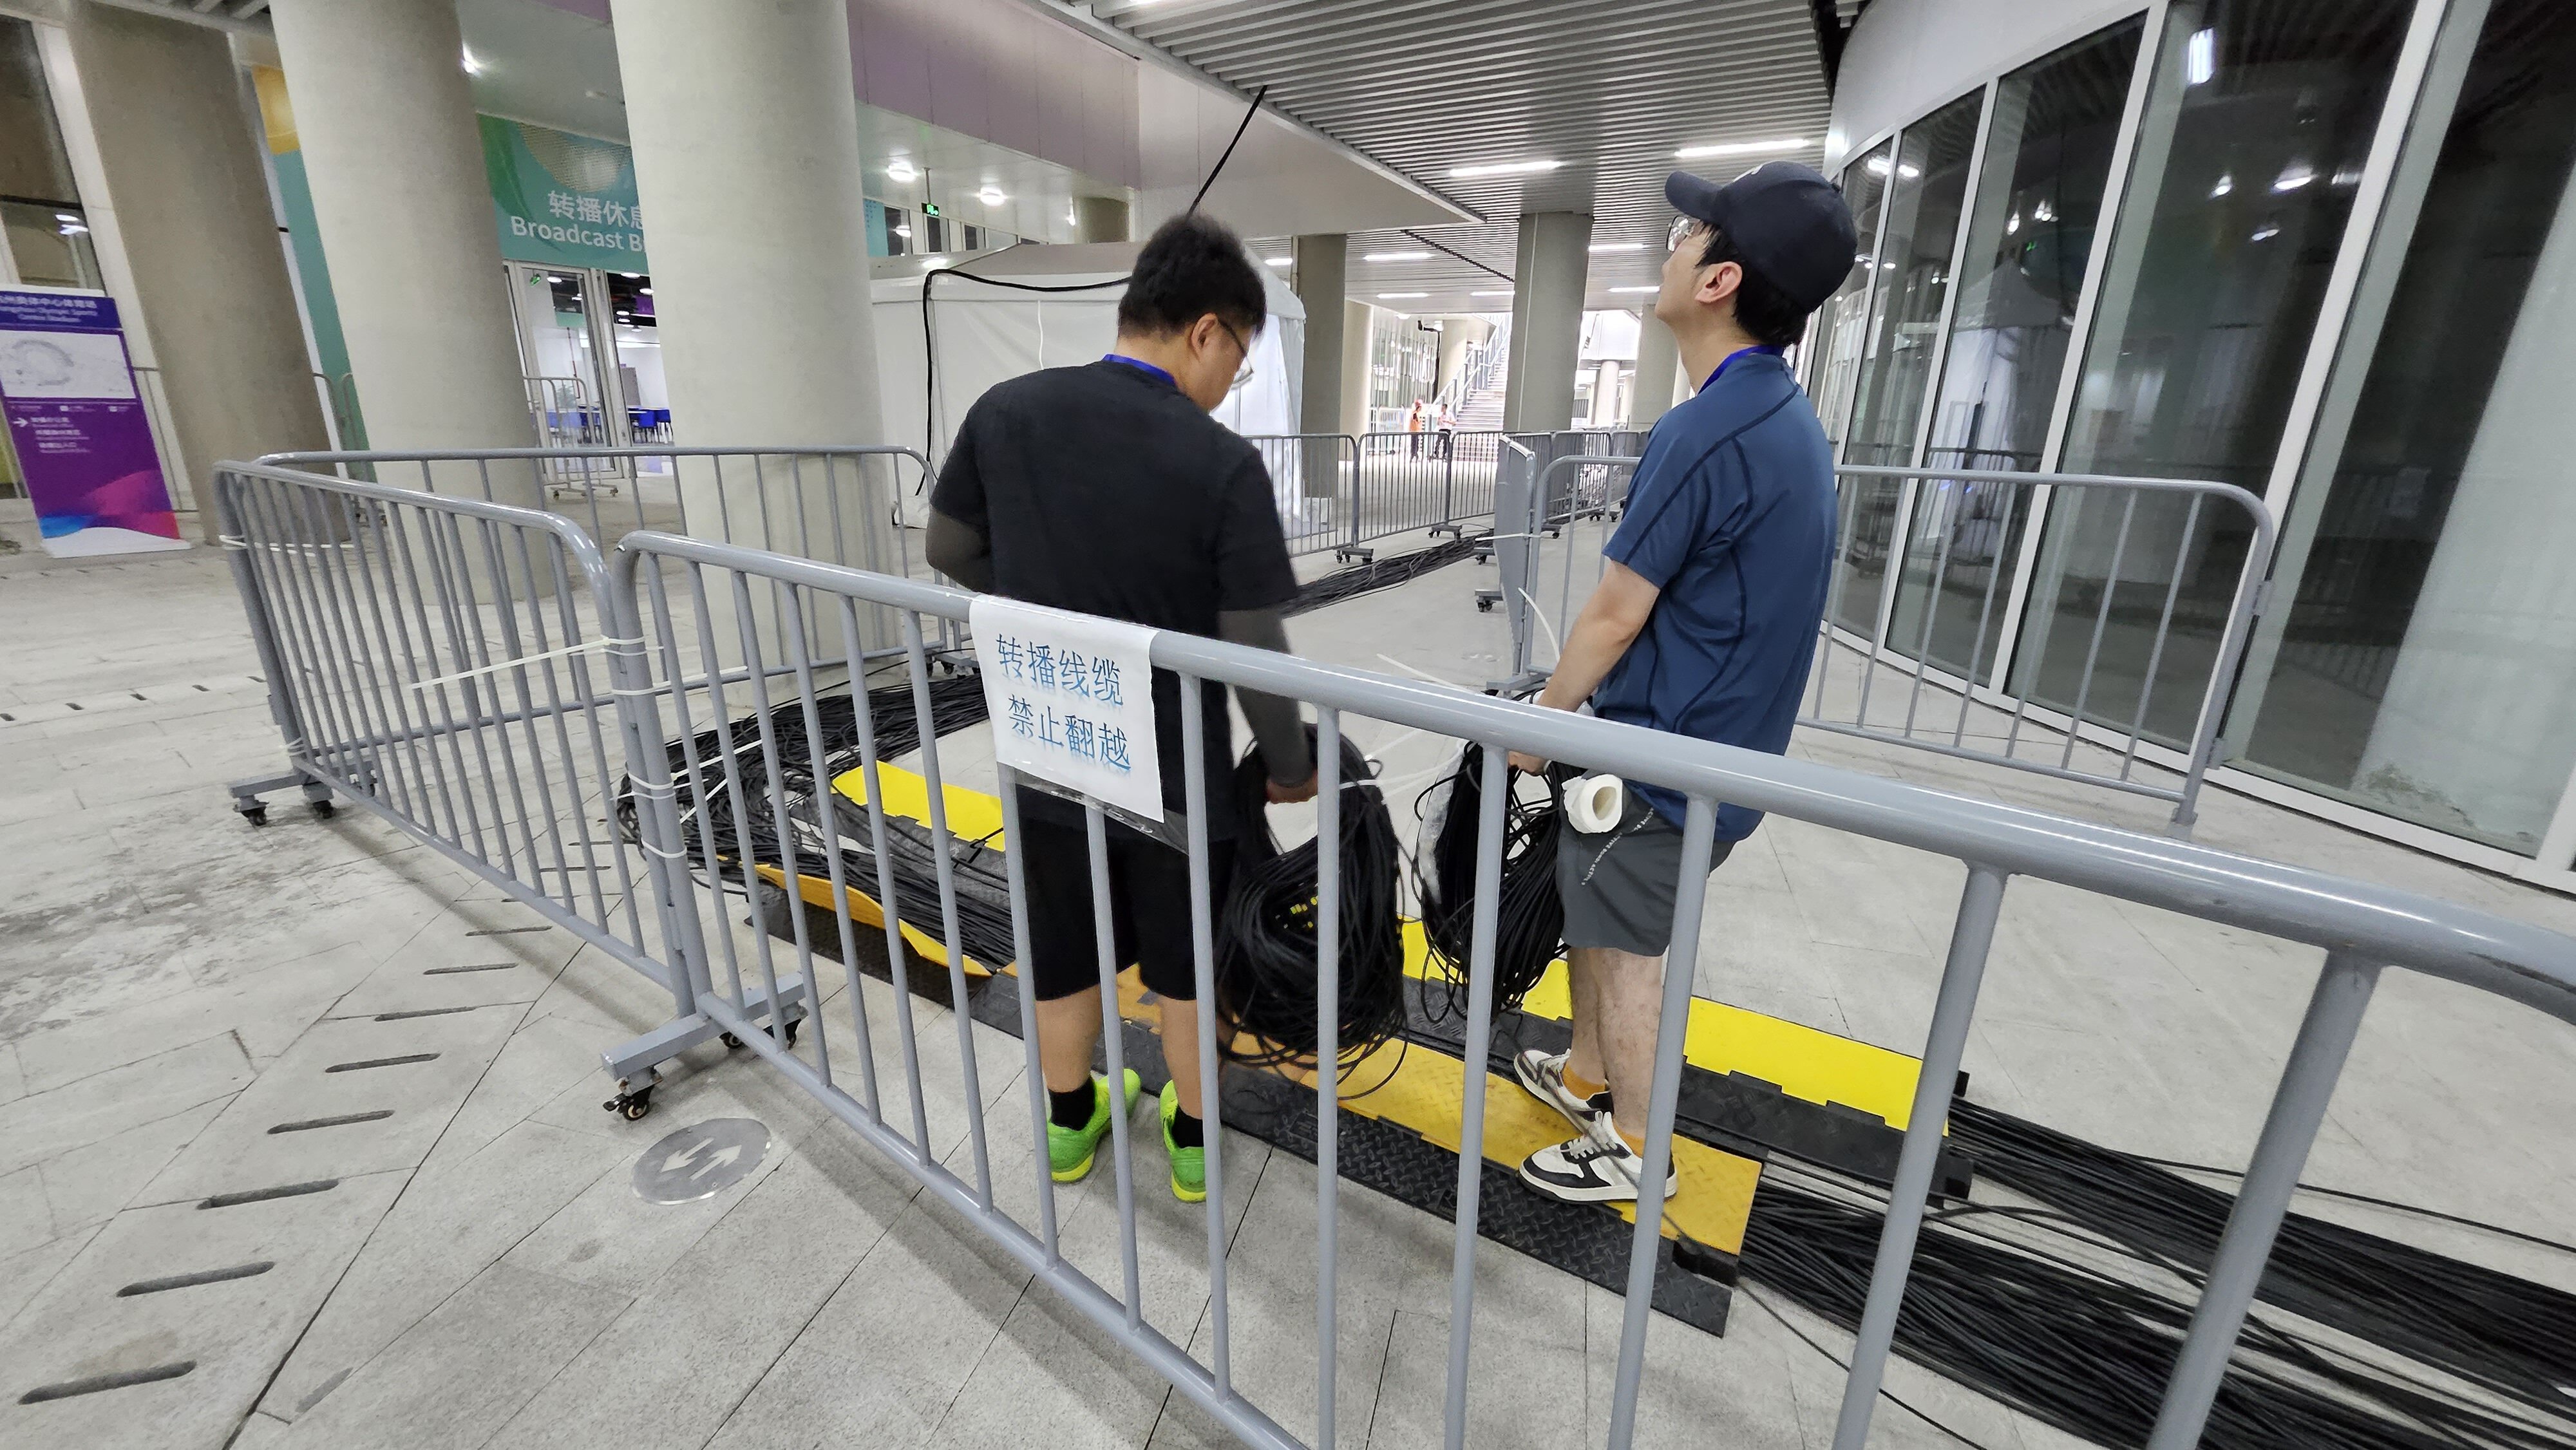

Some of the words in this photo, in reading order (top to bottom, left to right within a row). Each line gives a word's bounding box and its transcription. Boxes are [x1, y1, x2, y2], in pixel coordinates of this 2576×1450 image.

[511, 216, 623, 249] Broadcast
[629, 233, 645, 252] B
[996, 634, 1123, 706] 转播线缆
[1009, 695, 1131, 770] 禁止翻越
